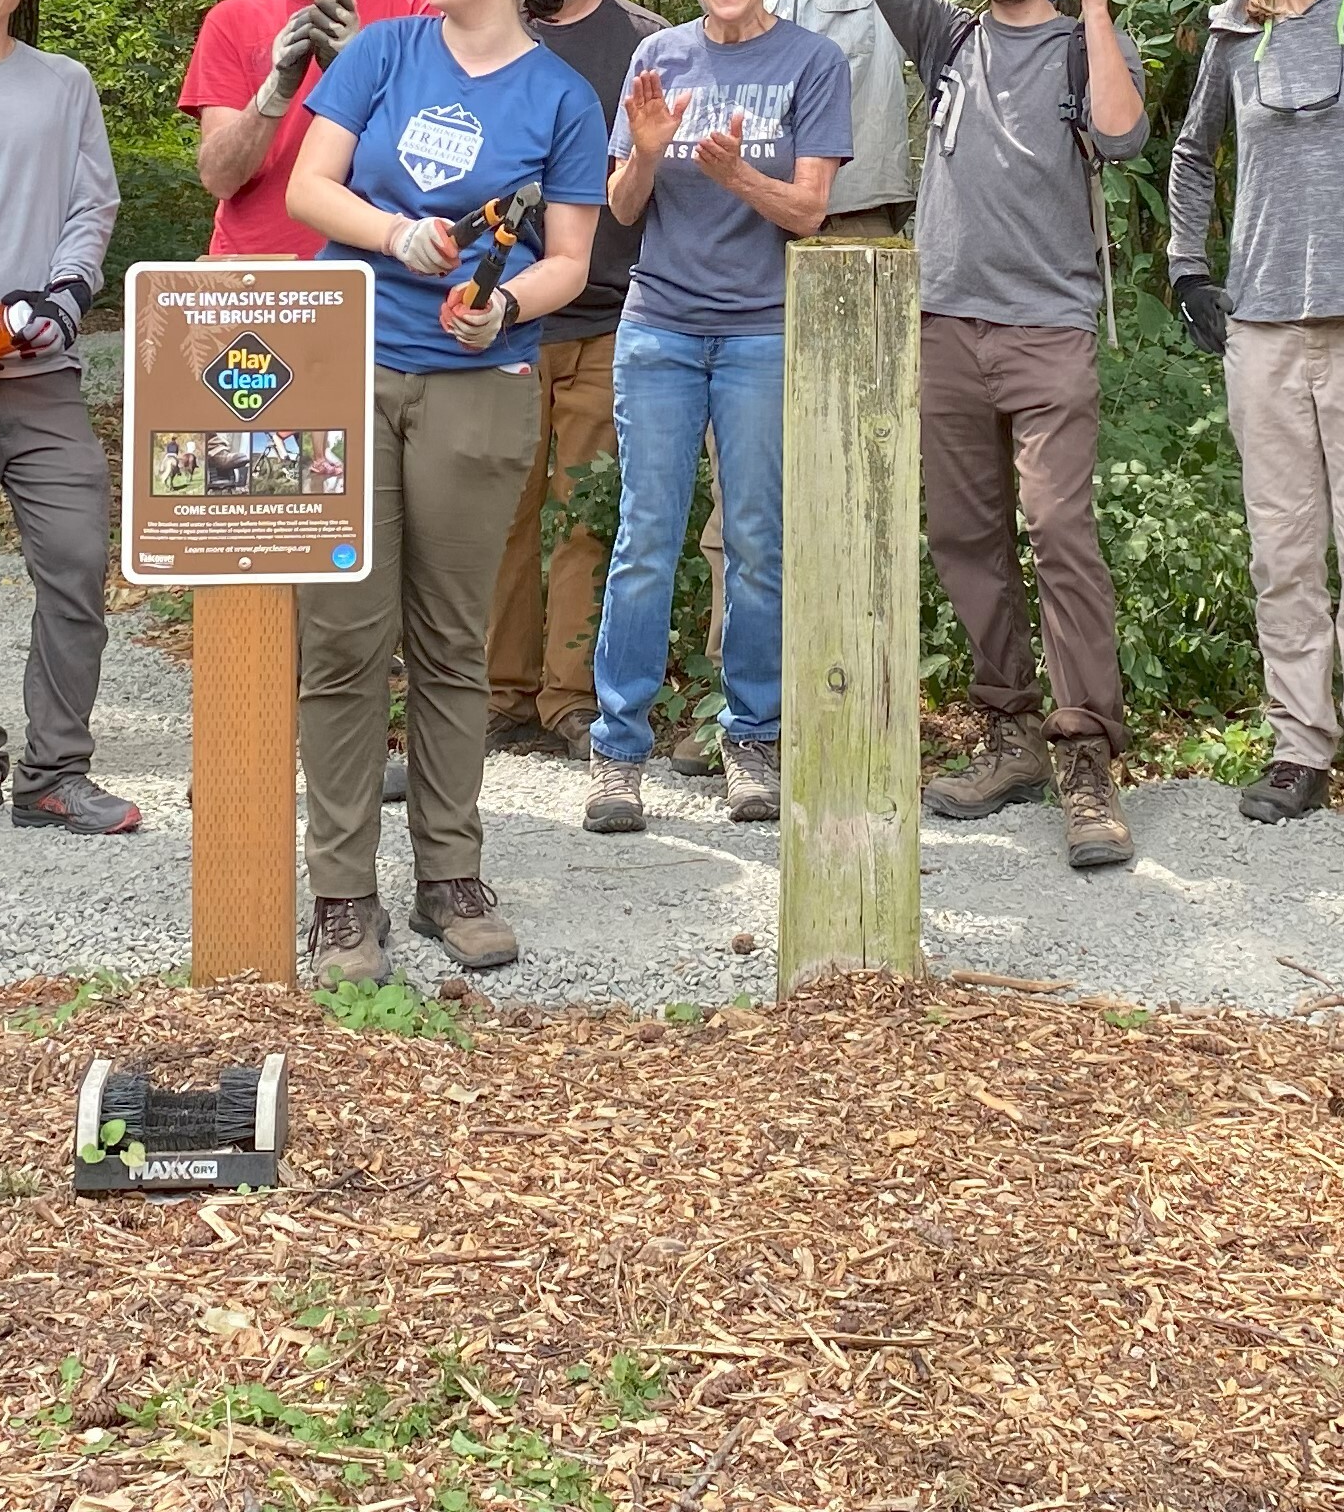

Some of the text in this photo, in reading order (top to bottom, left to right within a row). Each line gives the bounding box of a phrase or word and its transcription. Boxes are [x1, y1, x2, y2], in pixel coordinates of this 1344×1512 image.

[414, 121, 478, 144] WASHINGTON
[409, 129, 475, 157] TRAILS
[663, 143, 776, 159] ASTON
[402, 141, 471, 166] ASSOCIATION
[157, 291, 344, 307] GIVE INVASIVE SPECIES
[184, 309, 316, 324] THE BRUSH OFF!
[227, 348, 272, 374] Play
[218, 369, 277, 390] Clean
[232, 390, 263, 410] Go
[173, 503, 323, 516] COME CLEAN, LEAVE CLEAN
[184, 545, 204, 554] Learn
[205, 546, 224, 554] more
[225, 545, 234, 554] at
[128, 1160, 191, 1181] MAXX
